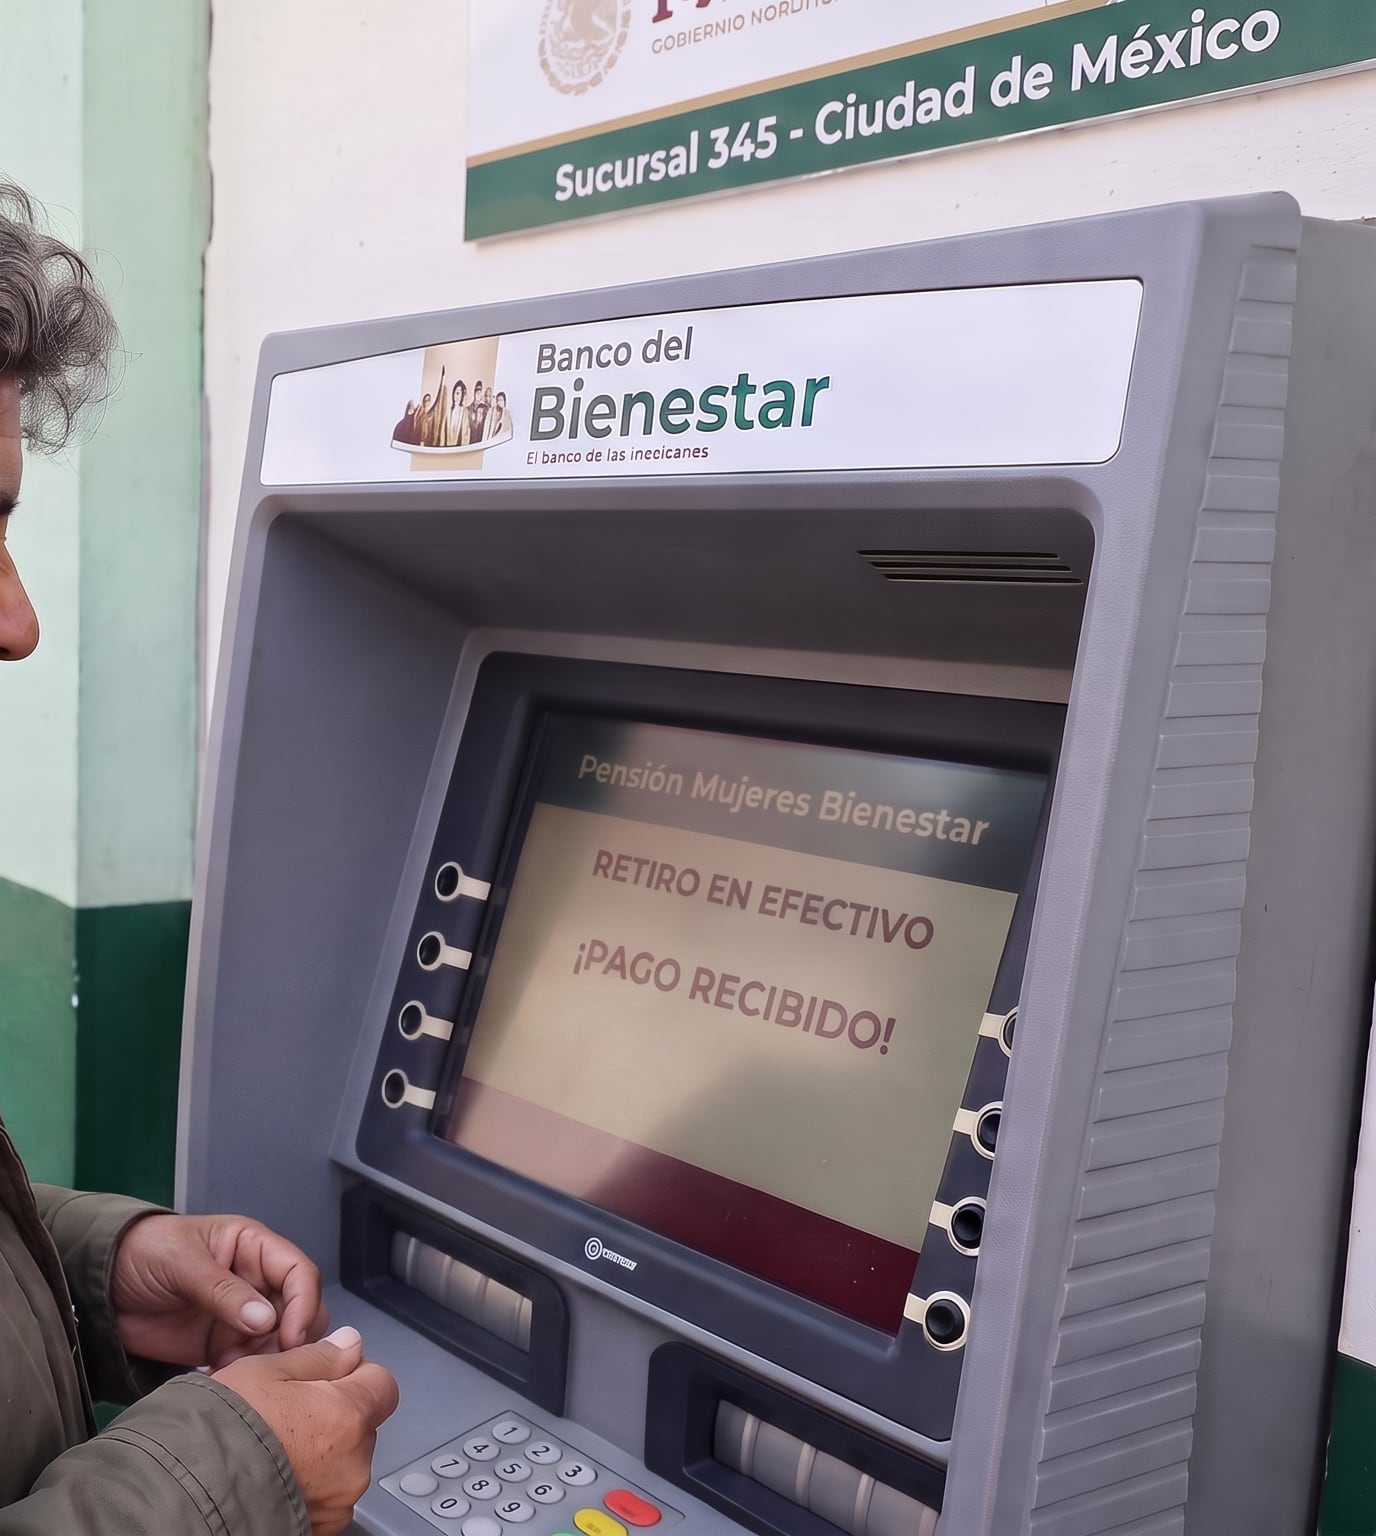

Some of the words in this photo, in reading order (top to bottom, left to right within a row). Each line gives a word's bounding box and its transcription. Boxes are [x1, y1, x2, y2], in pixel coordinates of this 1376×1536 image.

[651, 14, 745, 54] GOBIERNIO
[554, 130, 699, 202] Sucursal
[707, 116, 778, 169] 345
[789, 128, 804, 140] -
[814, 65, 976, 145] Ciudad
[990, 54, 1054, 108] de
[1070, 6, 1281, 92] México
[536, 342, 632, 374] Banco
[641, 326, 694, 365] del
[529, 372, 831, 442] Bienestar
[526, 451, 538, 465] El
[541, 450, 582, 465] banco
[585, 448, 603, 463] de
[607, 447, 626, 462] las
[577, 754, 684, 796] Pensión
[691, 771, 811, 816] Mujeres
[818, 789, 990, 846] Bienestar
[591, 849, 701, 897] RETIRO
[706, 873, 753, 911] EN
[757, 884, 934, 950] EFECTIVO
[573, 938, 681, 992] ¡PAGO
[688, 966, 897, 1056] RECIBIDO!
[503, 1426, 519, 1437] 1
[472, 1444, 490, 1454] 4
[531, 1445, 551, 1457] 2
[439, 1458, 460, 1469] 7
[502, 1463, 522, 1475] 5
[564, 1465, 583, 1478] 3
[471, 1479, 490, 1491] 8
[534, 1484, 553, 1496] 6
[439, 1498, 458, 1510] 0
[502, 1502, 521, 1513] 9
